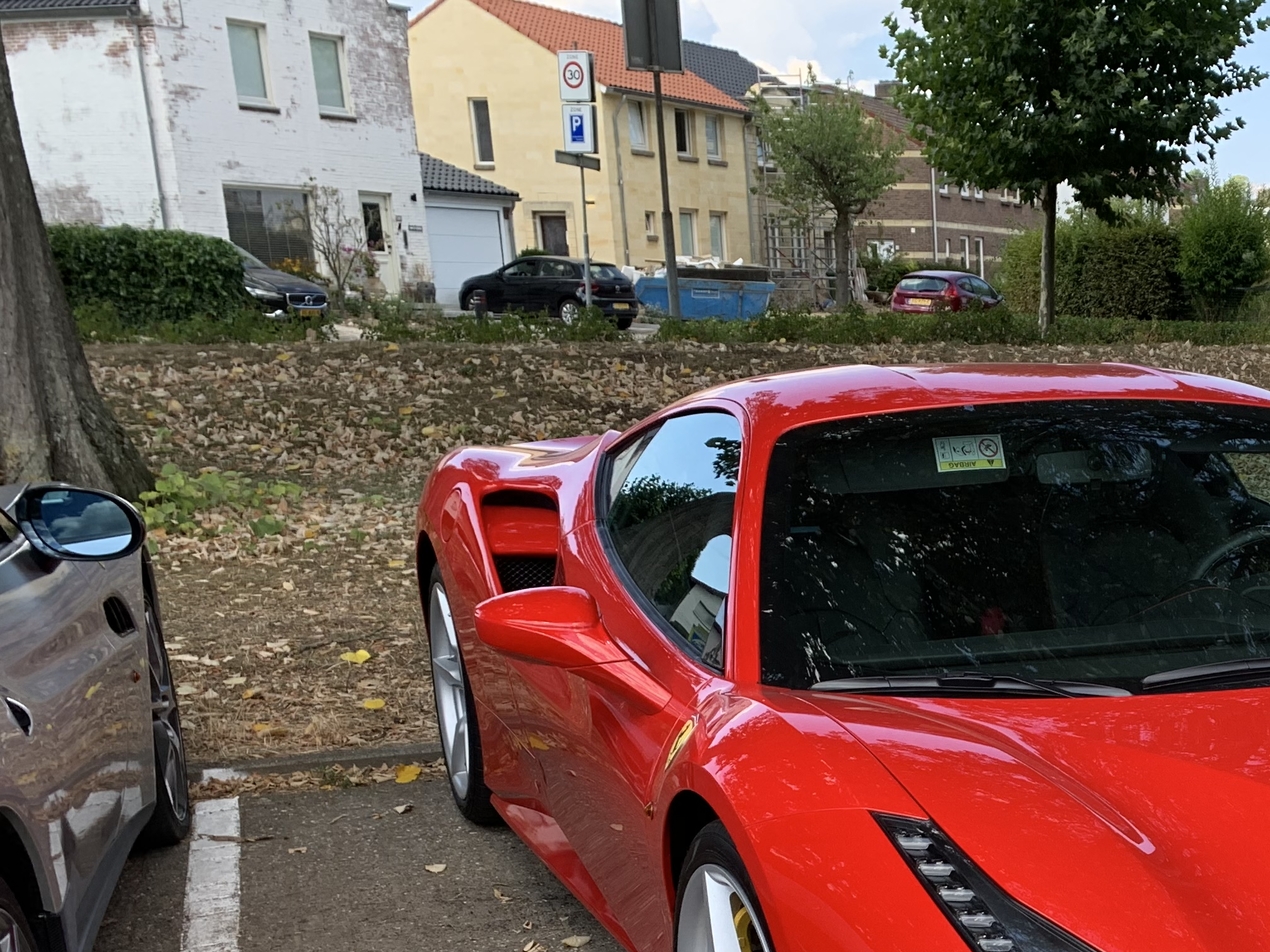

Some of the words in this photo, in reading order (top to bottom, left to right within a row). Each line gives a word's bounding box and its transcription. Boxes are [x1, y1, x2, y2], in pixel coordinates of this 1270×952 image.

[567, 69, 580, 80] 30
[572, 116, 581, 131] P
[948, 461, 976, 469] AIRBAG
